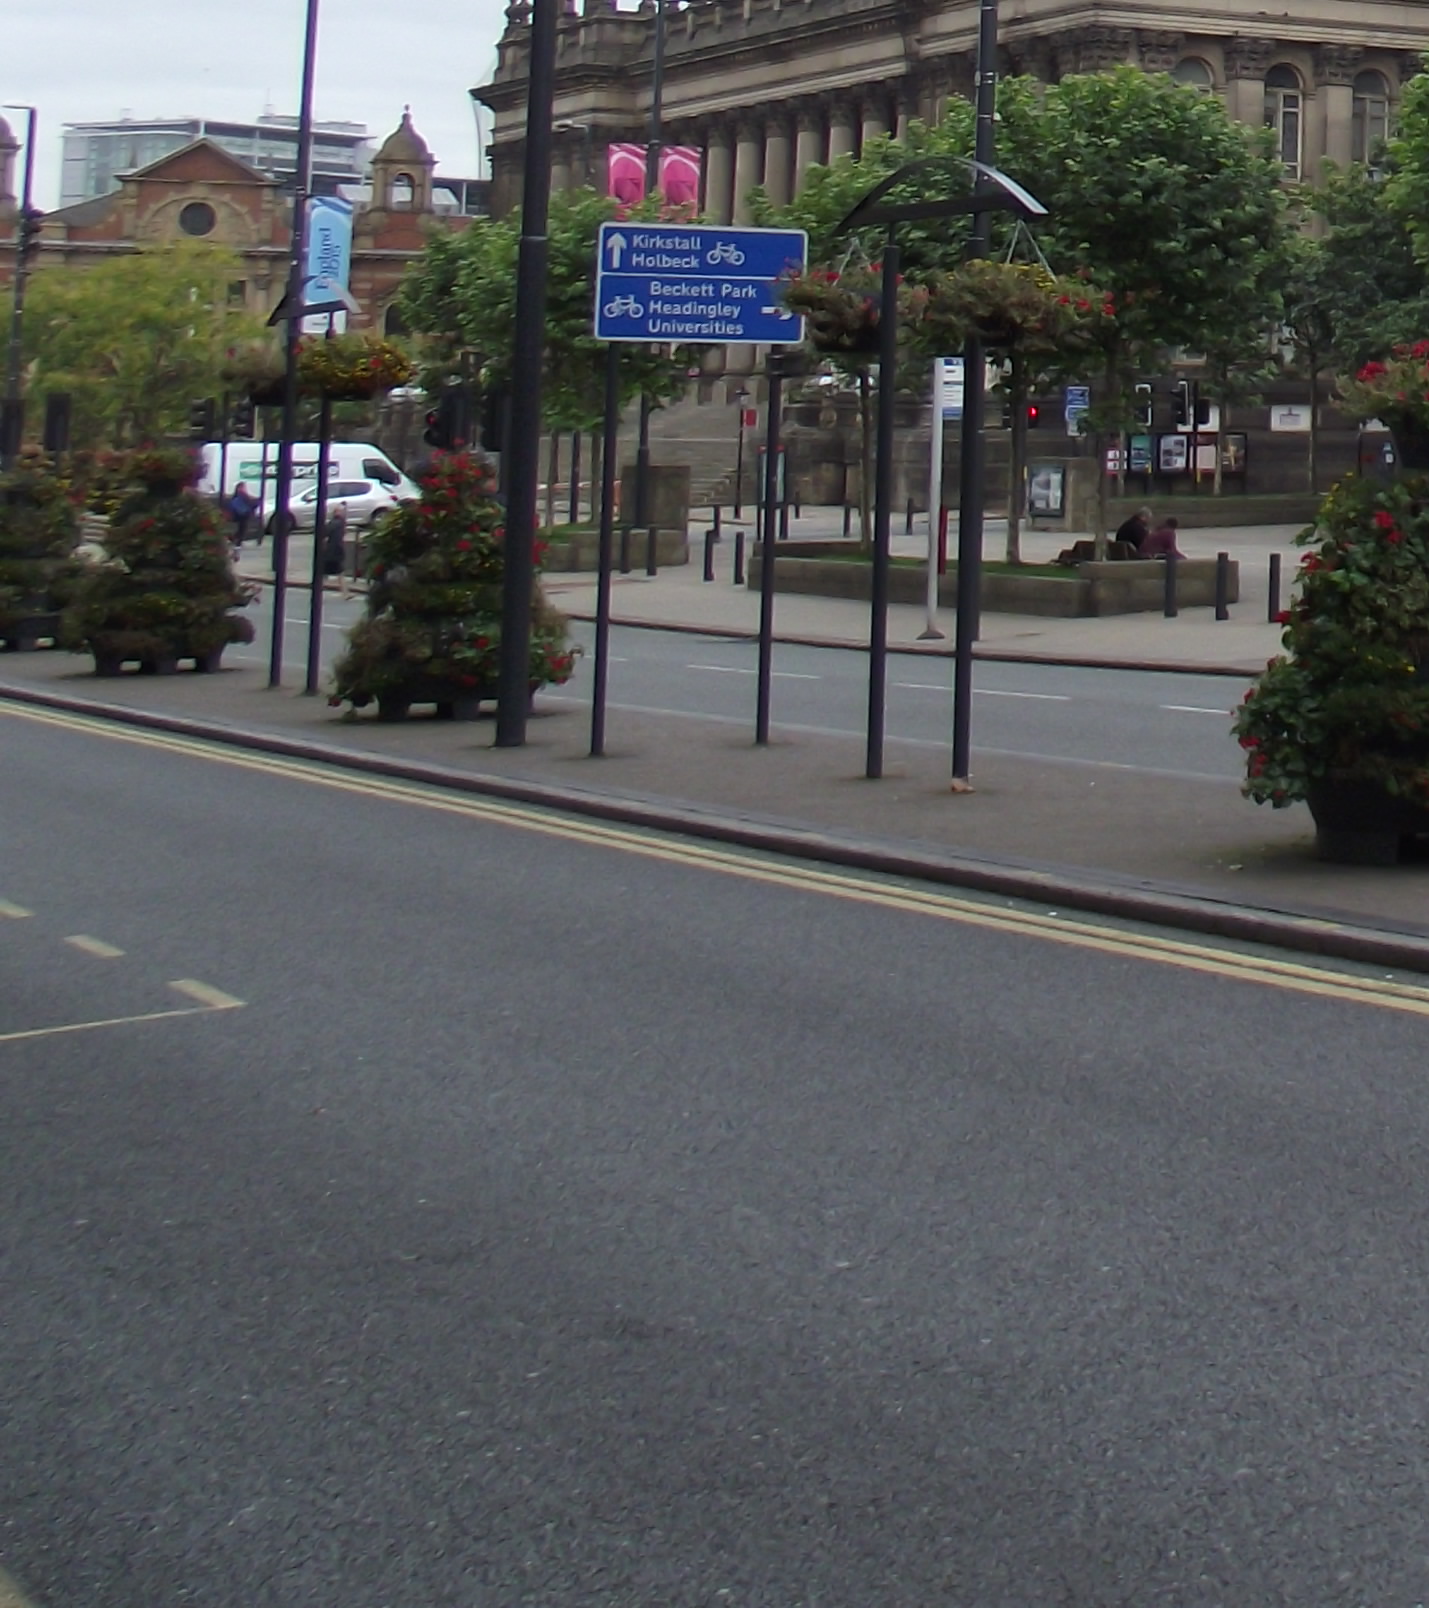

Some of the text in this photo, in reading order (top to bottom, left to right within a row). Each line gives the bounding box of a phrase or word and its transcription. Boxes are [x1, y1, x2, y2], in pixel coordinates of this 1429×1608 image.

[632, 234, 702, 250] Kirkstall
[631, 253, 700, 268] Holbeck
[650, 280, 758, 298] Beckett Park
[649, 300, 741, 318] Headingley
[648, 318, 744, 335] Universities
